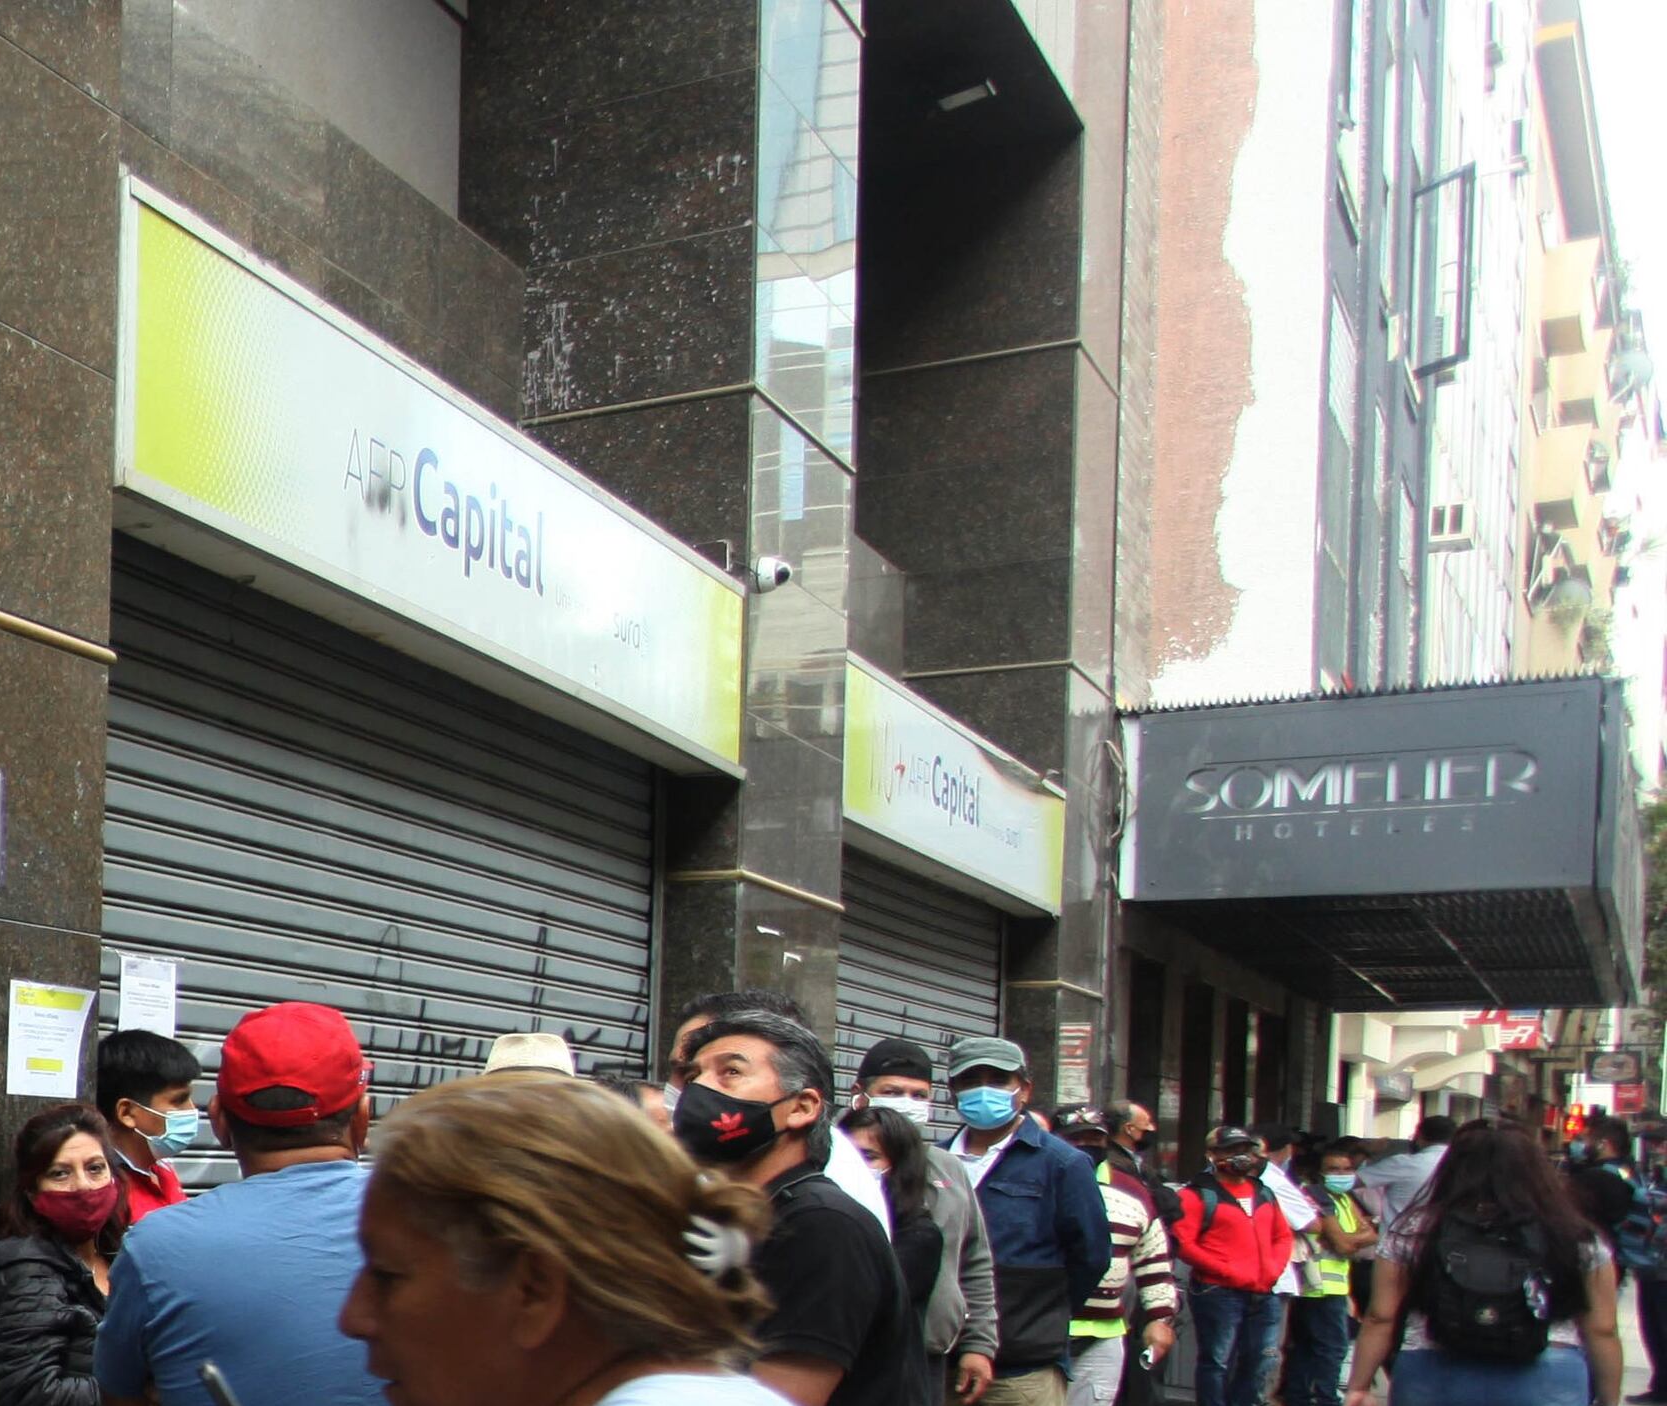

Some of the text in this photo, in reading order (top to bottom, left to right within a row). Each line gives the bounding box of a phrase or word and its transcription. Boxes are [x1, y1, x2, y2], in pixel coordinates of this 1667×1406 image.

[343, 428, 545, 597] AFP Capital
[931, 755, 980, 827] Capital
[1234, 815, 1474, 841] HOTELES
